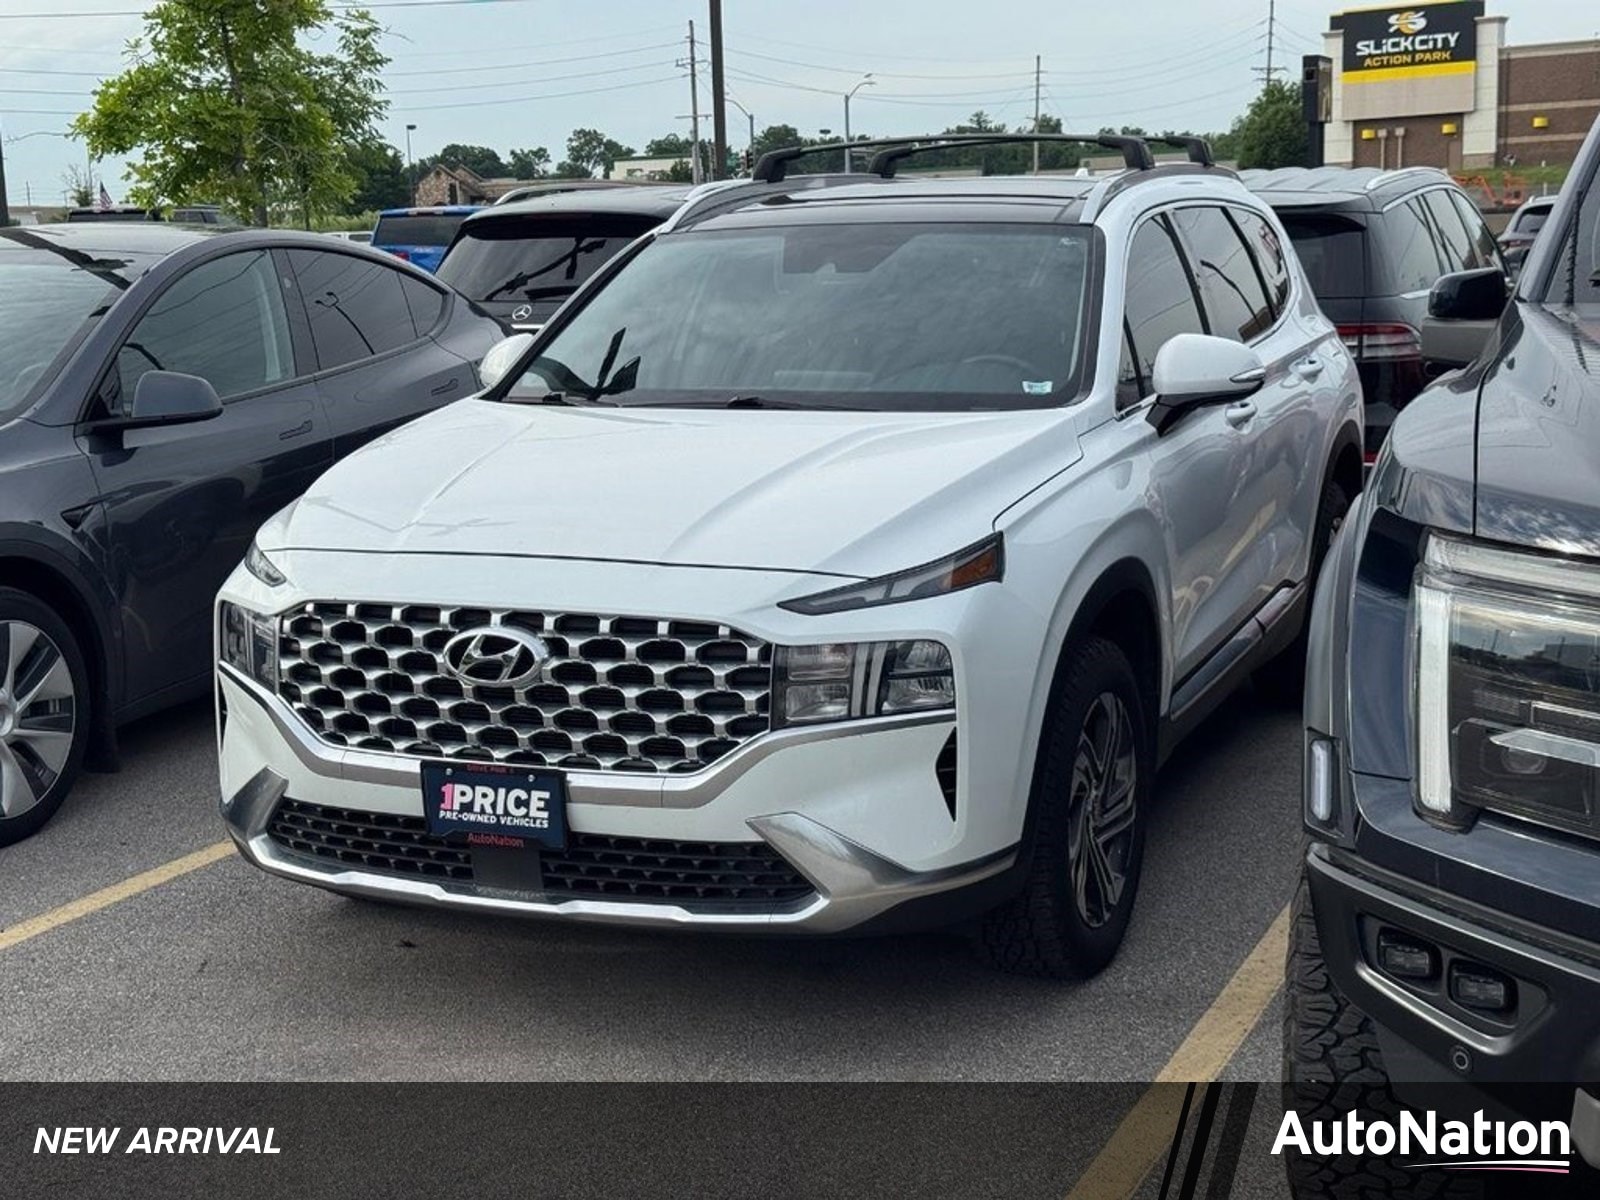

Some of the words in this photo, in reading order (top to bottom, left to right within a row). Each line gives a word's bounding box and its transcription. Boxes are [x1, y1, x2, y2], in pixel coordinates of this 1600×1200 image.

[1364, 55, 1411, 67] ACTION
[1415, 51, 1451, 62] PARK
[440, 783, 550, 818] 1PRICE
[439, 811, 497, 824] PRE-OWNED
[500, 816, 549, 828] VEHICLES
[467, 833, 524, 847] AutoNation
